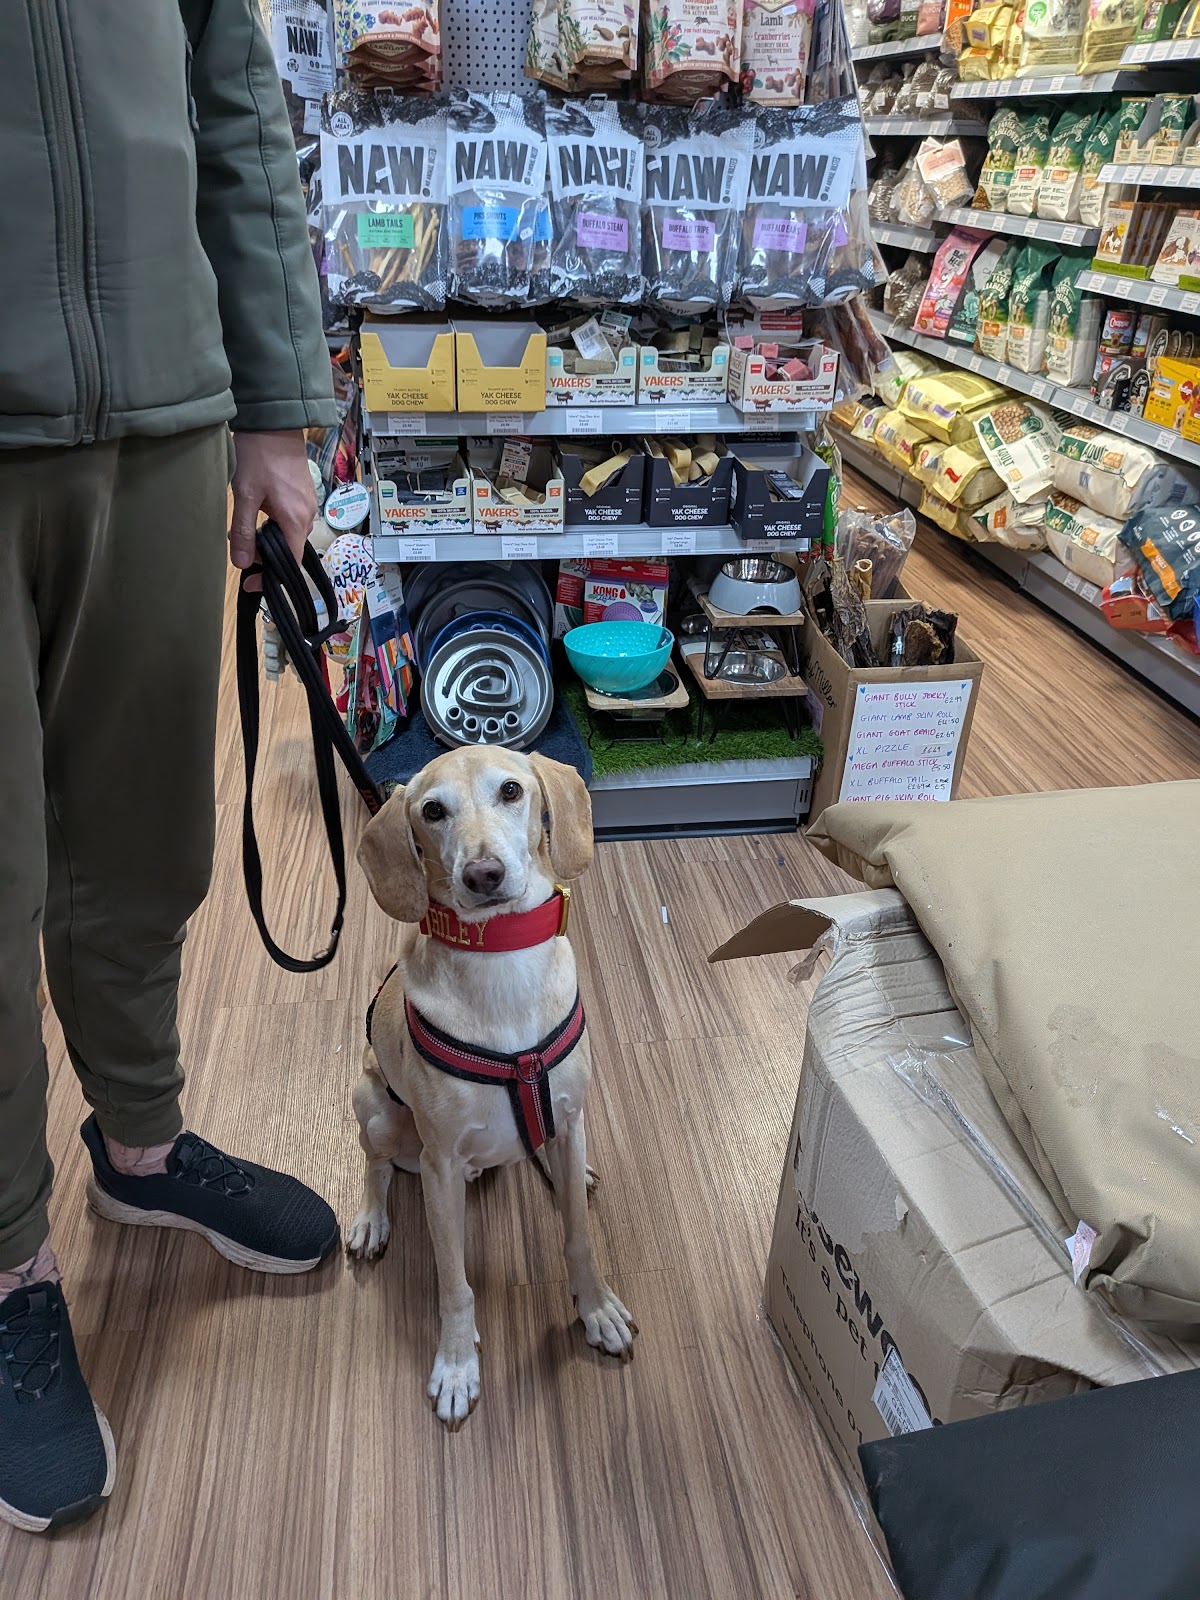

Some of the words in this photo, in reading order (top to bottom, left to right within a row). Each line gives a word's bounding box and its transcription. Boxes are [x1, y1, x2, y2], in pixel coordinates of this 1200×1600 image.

[760, 13, 783, 26] Lamb
[754, 32, 791, 41] Cranberries
[455, 140, 539, 186] NAW!
[337, 144, 437, 198] NAW!
[368, 219, 386, 228] LAMB
[387, 219, 404, 229] TAILS
[582, 218, 606, 230] BUFFALO
[607, 221, 624, 233] STEAK
[668, 223, 693, 234] BUFFALO
[694, 225, 710, 235] TRIPE
[549, 377, 592, 388] YAKERS
[643, 376, 684, 386] YAKERS
[750, 384, 790, 395] YAKERS
[384, 508, 426, 518] YAKERS
[478, 508, 519, 517] YAKERS
[593, 585, 619, 598] KONG
[864, 693, 890, 703] GIANT
[893, 693, 918, 701] BULLY
[922, 692, 948, 700] JERKY
[860, 714, 887, 722] GIANT
[891, 713, 913, 721] LAMB
[916, 711, 933, 719] SKIN
[936, 710, 953, 718] ROLL
[856, 731, 883, 739] GIANT
[888, 729, 910, 737] GOAT
[914, 728, 937, 736] BRAID
[856, 747, 868, 755] XL
[874, 743, 910, 754] PIZZLE
[852, 762, 878, 771] MEGA
[881, 760, 915, 768] BUFFALO
[917, 759, 939, 767] STICK
[849, 779, 862, 787] XL
[868, 777, 903, 786] BUFFALO
[906, 775, 928, 784] TAIL
[895, 793, 914, 801] SKIN
[917, 793, 938, 802] ROLL
[795, 1205, 817, 1262] It's
[820, 1265, 831, 1293] a
[836, 1292, 867, 1362] pet
[780, 1265, 843, 1408] Telephone
